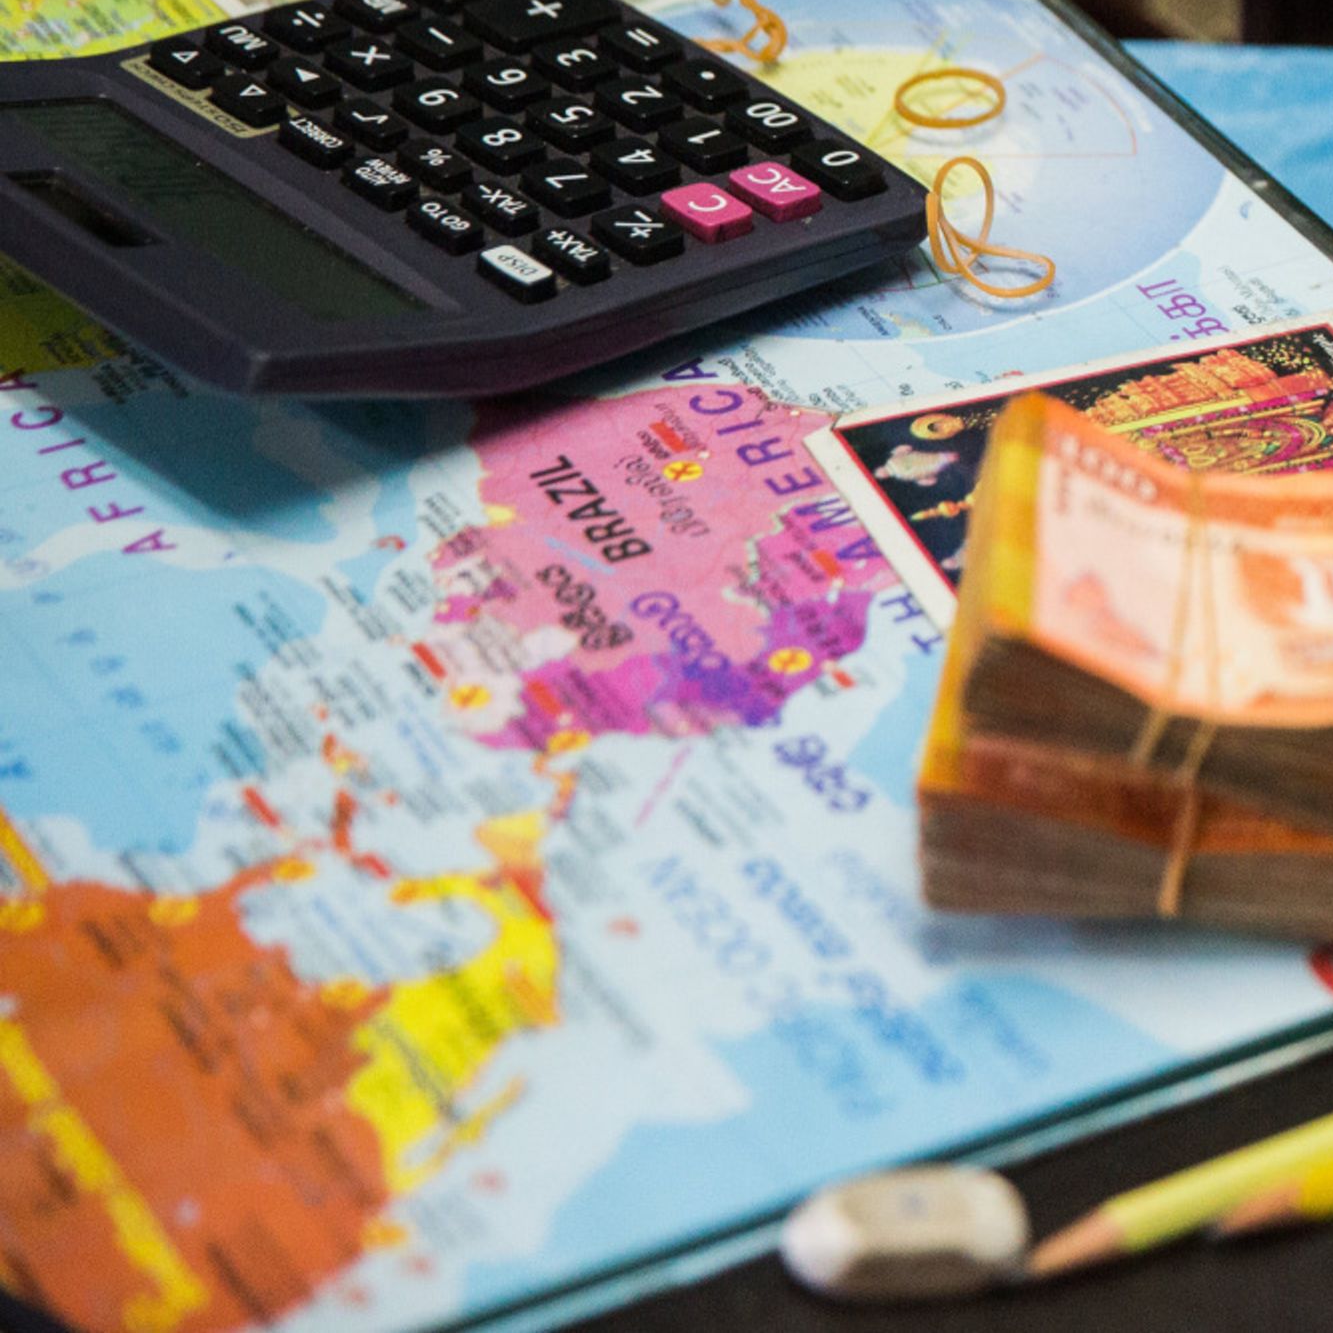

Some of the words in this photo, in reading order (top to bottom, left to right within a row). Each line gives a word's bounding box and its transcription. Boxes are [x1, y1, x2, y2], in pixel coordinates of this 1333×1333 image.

[220, 25, 266, 50] MU
[557, 49, 597, 66] 3
[487, 69, 527, 85] 6
[419, 89, 458, 106] 9
[622, 86, 662, 104] 2
[551, 106, 593, 123] 5
[746, 102, 798, 127] 00
[289, 119, 344, 148] CORRECT
[483, 129, 522, 146] 8
[688, 130, 721, 144] 1
[619, 149, 654, 163] 4
[822, 150, 859, 166] 0
[546, 174, 587, 188] 7
[747, 167, 806, 193] AC
[479, 185, 527, 215] TAX-
[687, 194, 728, 212] C
[548, 230, 598, 261] TAX+
[500, 253, 538, 276] DISP
[0, 368, 178, 555] AFRICA
[661, 356, 883, 562] AMERICA
[530, 454, 653, 563] BRAZIL
